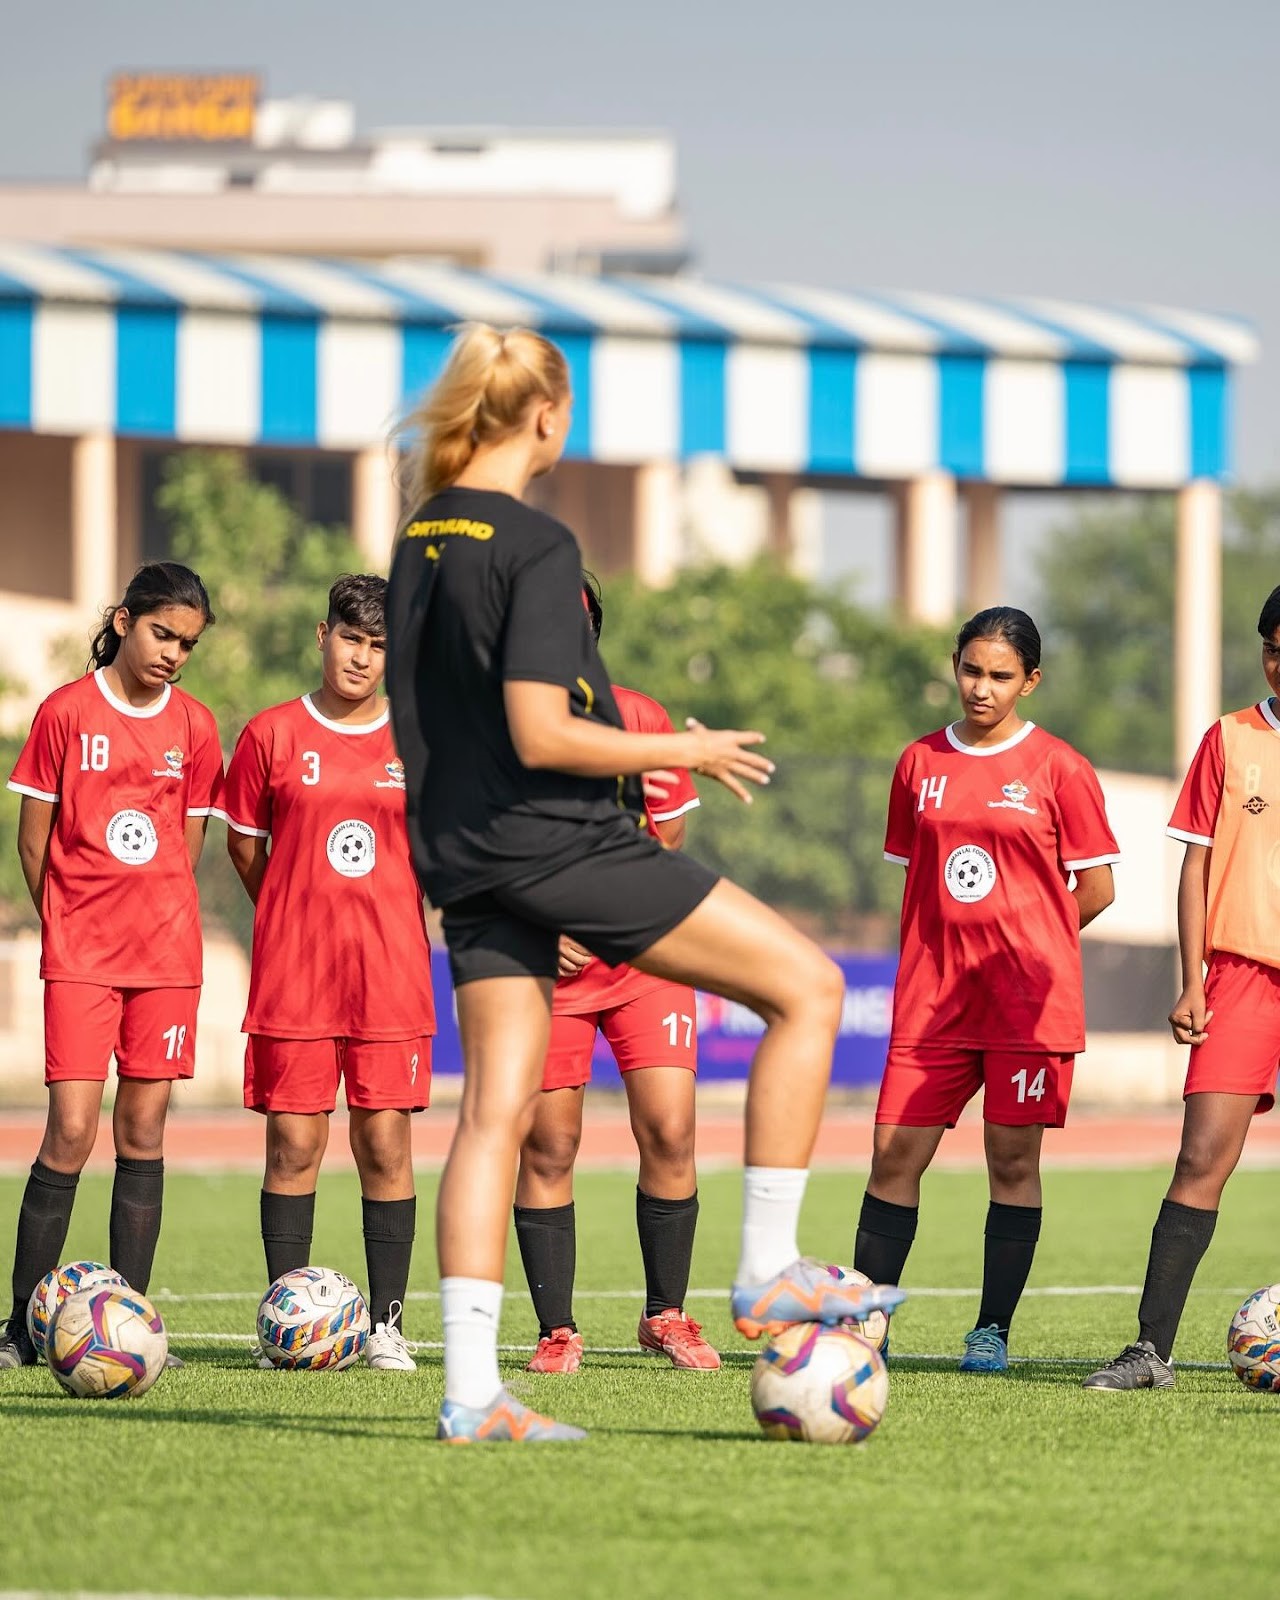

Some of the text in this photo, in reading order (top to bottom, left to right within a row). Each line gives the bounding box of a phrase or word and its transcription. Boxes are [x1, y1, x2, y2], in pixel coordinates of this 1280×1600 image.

[406, 518, 495, 541] ORTMUND
[80, 733, 110, 772] 18
[301, 750, 320, 786] 3
[917, 775, 948, 812] 14
[1244, 764, 1261, 796] 8
[661, 1012, 693, 1049] 17
[1010, 1067, 1047, 1103] 14
